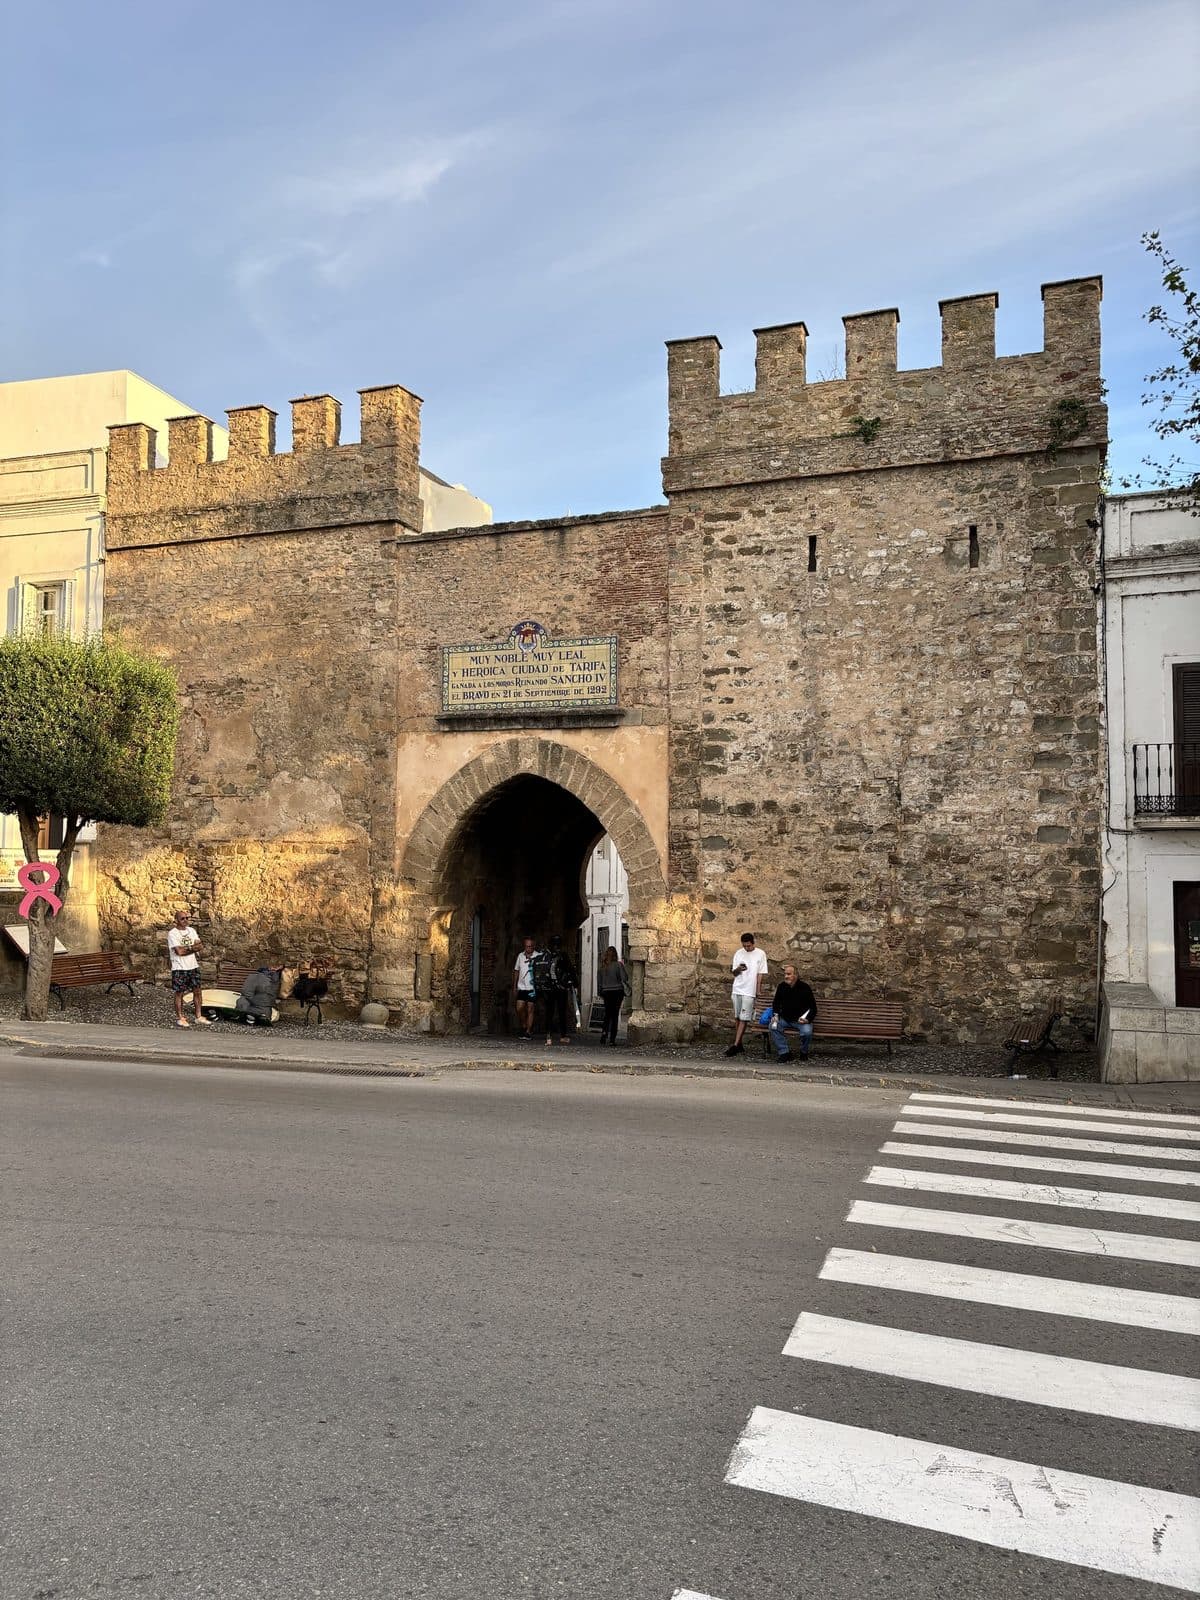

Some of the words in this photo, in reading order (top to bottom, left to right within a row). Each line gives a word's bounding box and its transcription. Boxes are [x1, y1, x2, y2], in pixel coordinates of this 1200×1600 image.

[470, 655, 490, 665] MUY
[494, 653, 528, 665] NOBLE
[533, 651, 555, 661] MUY
[559, 650, 586, 660] LEAL
[462, 666, 505, 677] HEROICA
[512, 664, 548, 675] CIUDAD
[570, 661, 606, 672] TARIFA
[495, 680, 514, 688] MOROS
[550, 673, 592, 684] SANCHO
[595, 673, 606, 683] IV
[463, 690, 489, 700] BRAVO
[503, 690, 511, 698] 21
[587, 685, 607, 695] 1292
